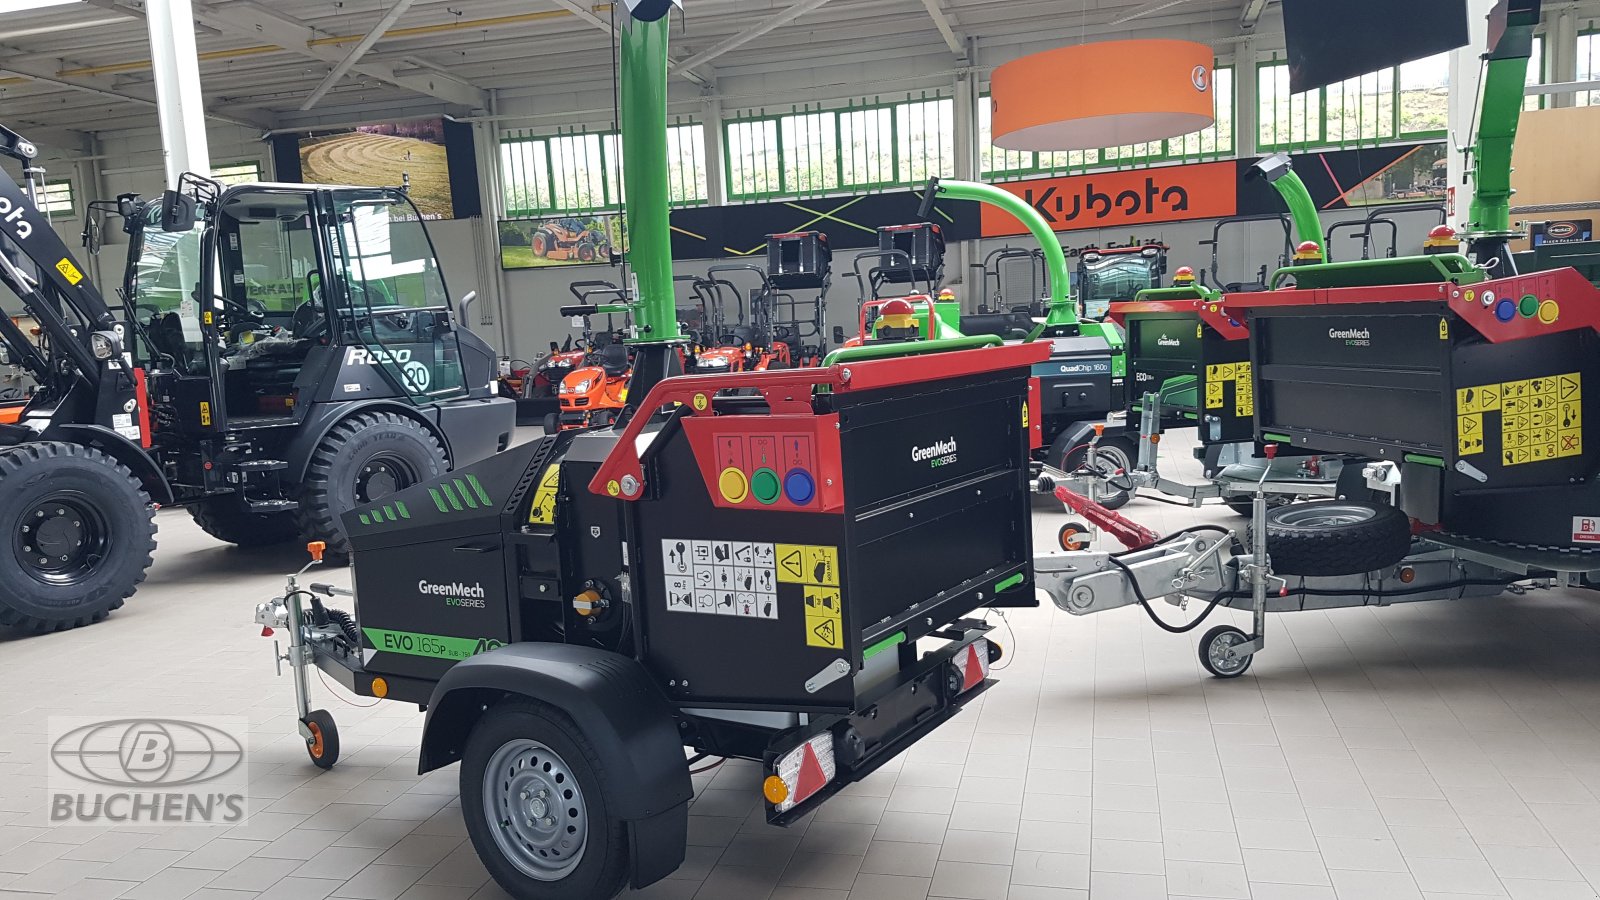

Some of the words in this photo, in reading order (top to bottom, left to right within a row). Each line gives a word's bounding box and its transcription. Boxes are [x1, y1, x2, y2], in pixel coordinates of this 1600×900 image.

[1025, 178, 1188, 222] Kubota
[406, 210, 442, 221] Buhen's
[1328, 327, 1370, 339] GreenMech
[1060, 363, 1092, 373] QuadChip
[407, 367, 427, 387] 20
[911, 435, 957, 462] GreenMech
[930, 453, 958, 468] EVOSERIES
[418, 579, 485, 598] GreenMech
[446, 597, 486, 609] EVOSERIES
[384, 633, 413, 651] EVO
